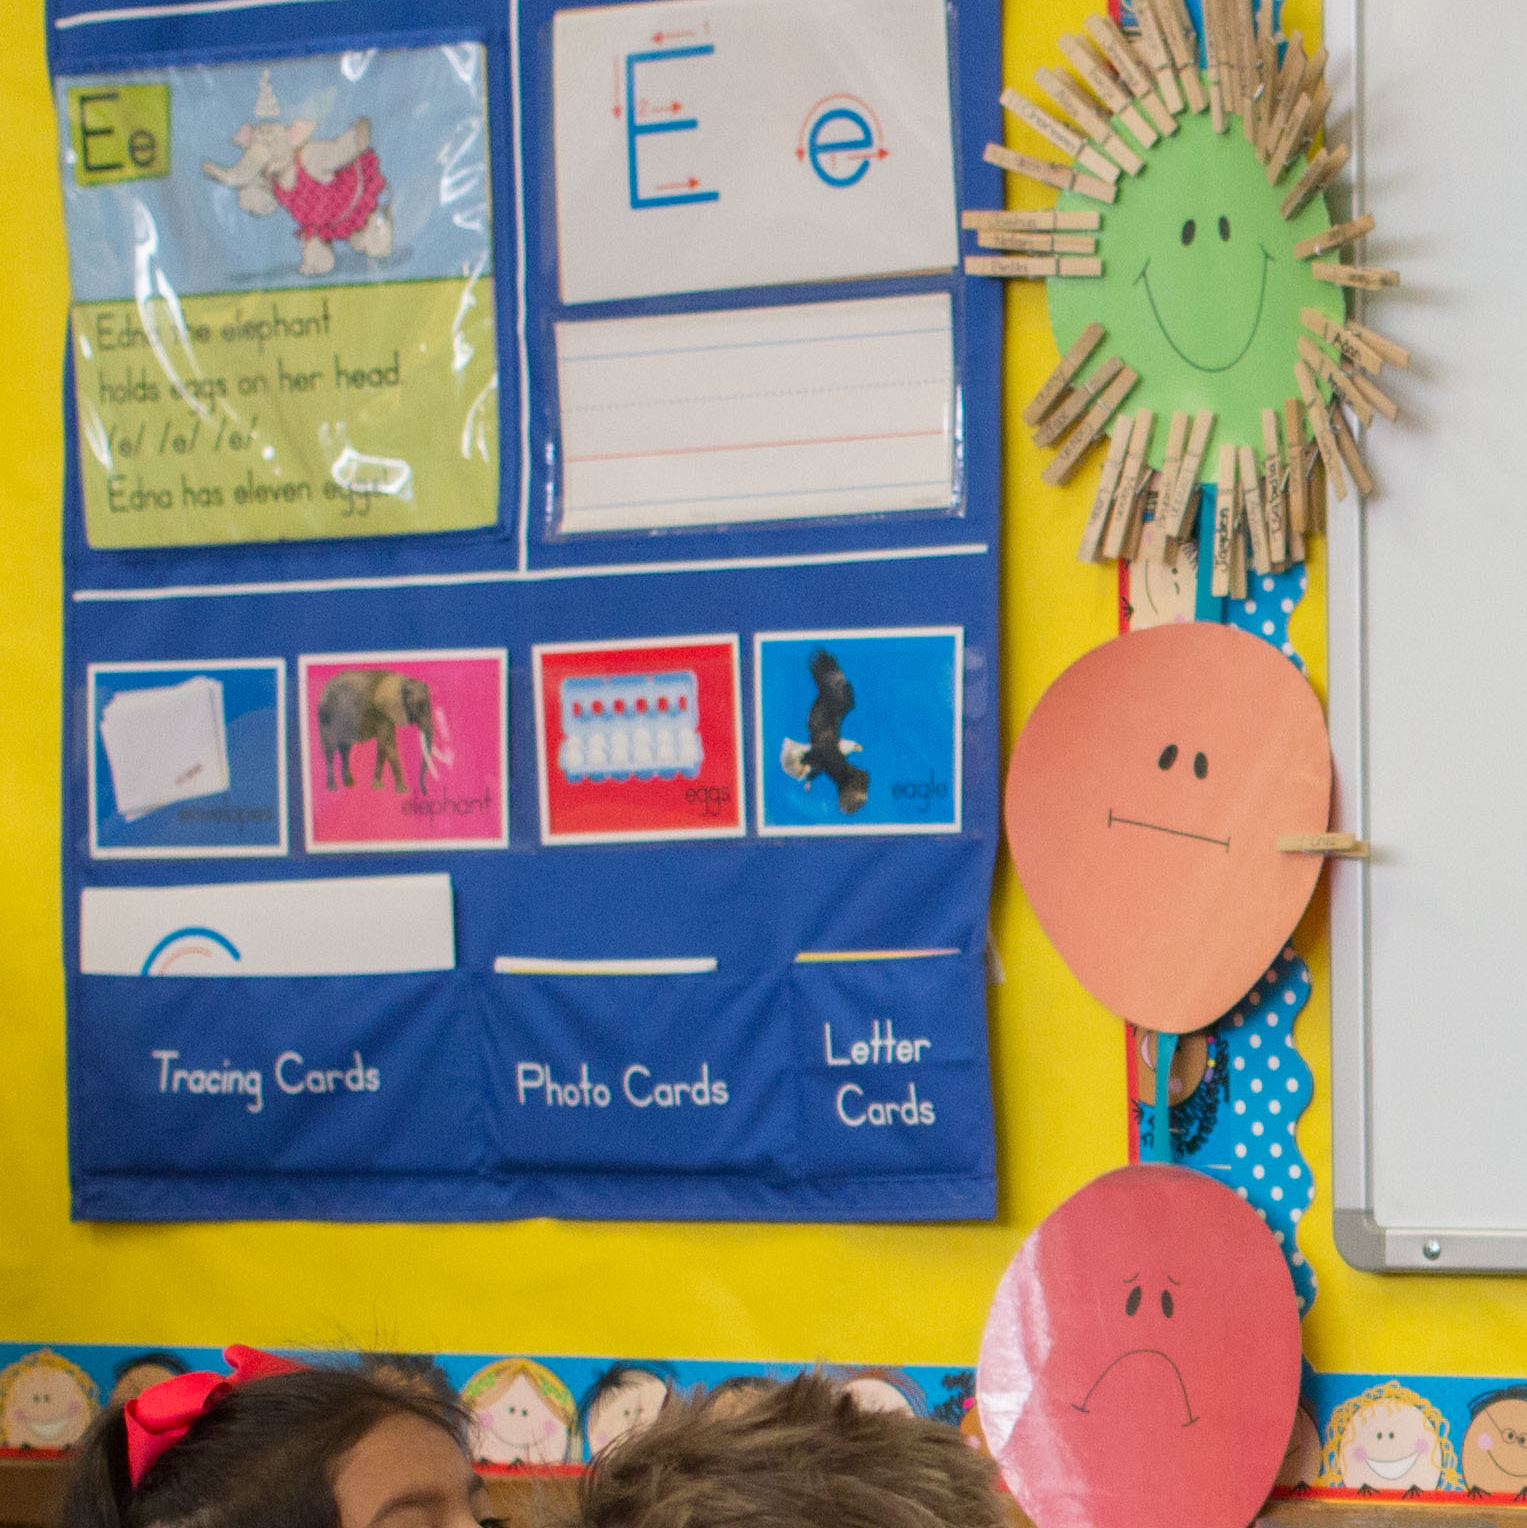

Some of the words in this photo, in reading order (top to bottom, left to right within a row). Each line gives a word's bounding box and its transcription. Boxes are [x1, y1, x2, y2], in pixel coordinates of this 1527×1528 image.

[626, 44, 720, 210] E
[808, 108, 873, 188] e
[220, 300, 330, 354] elephant
[98, 364, 160, 404] holds
[237, 374, 267, 396] on
[277, 357, 322, 393] her
[107, 473, 173, 513] Edna
[180, 472, 224, 508] has
[233, 468, 311, 508] eleven
[401, 785, 491, 829] elephant
[684, 784, 731, 818] eggs
[890, 768, 948, 813] eagle
[824, 1019, 931, 1067] Letter
[152, 1051, 263, 1113] Tracing
[275, 1051, 380, 1095] Cards
[516, 1062, 610, 1107] Photo
[623, 1063, 729, 1107] Cards
[836, 1083, 935, 1127] Cards
